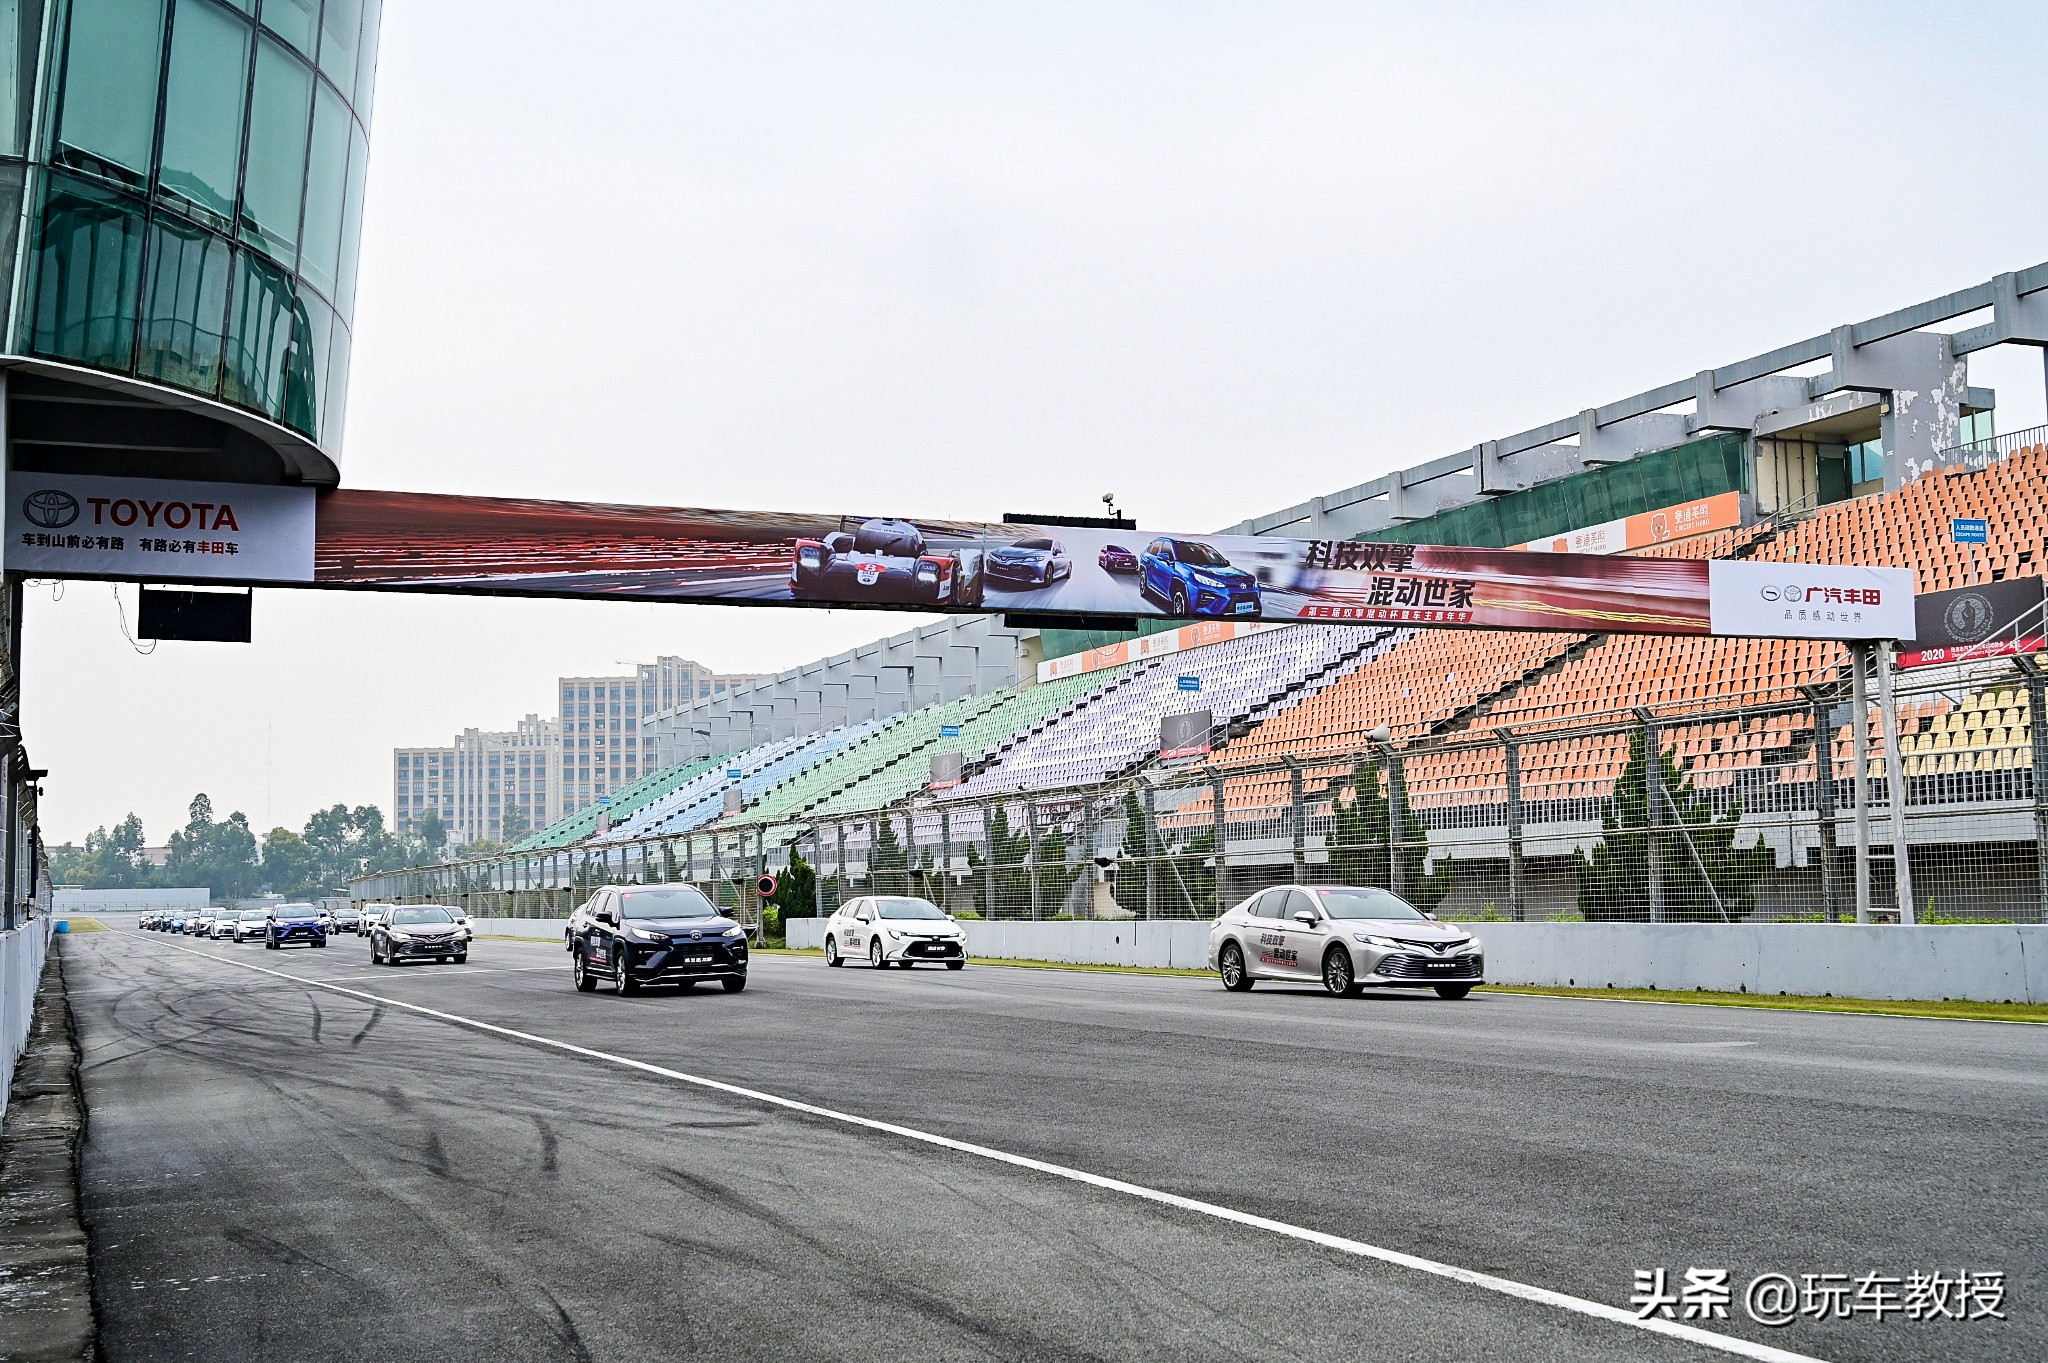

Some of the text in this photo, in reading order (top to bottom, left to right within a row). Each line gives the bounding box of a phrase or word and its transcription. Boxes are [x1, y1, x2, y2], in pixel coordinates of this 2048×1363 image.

[87, 497, 239, 532] TOYOTA
[1674, 518, 1710, 533] CIRCUIT HERO
[21, 532, 239, 555] 车到山前必有路 有路必有丰田车
[1305, 539, 1417, 573] 科技双擎
[1366, 576, 1476, 609] 混动世家
[1804, 586, 1881, 606] 广汽丰田
[1307, 606, 1467, 622] 第三届双擎混动杯暨车主嘉年华
[1784, 609, 1862, 624] 品质感动世界
[1920, 648, 1945, 662] 2020
